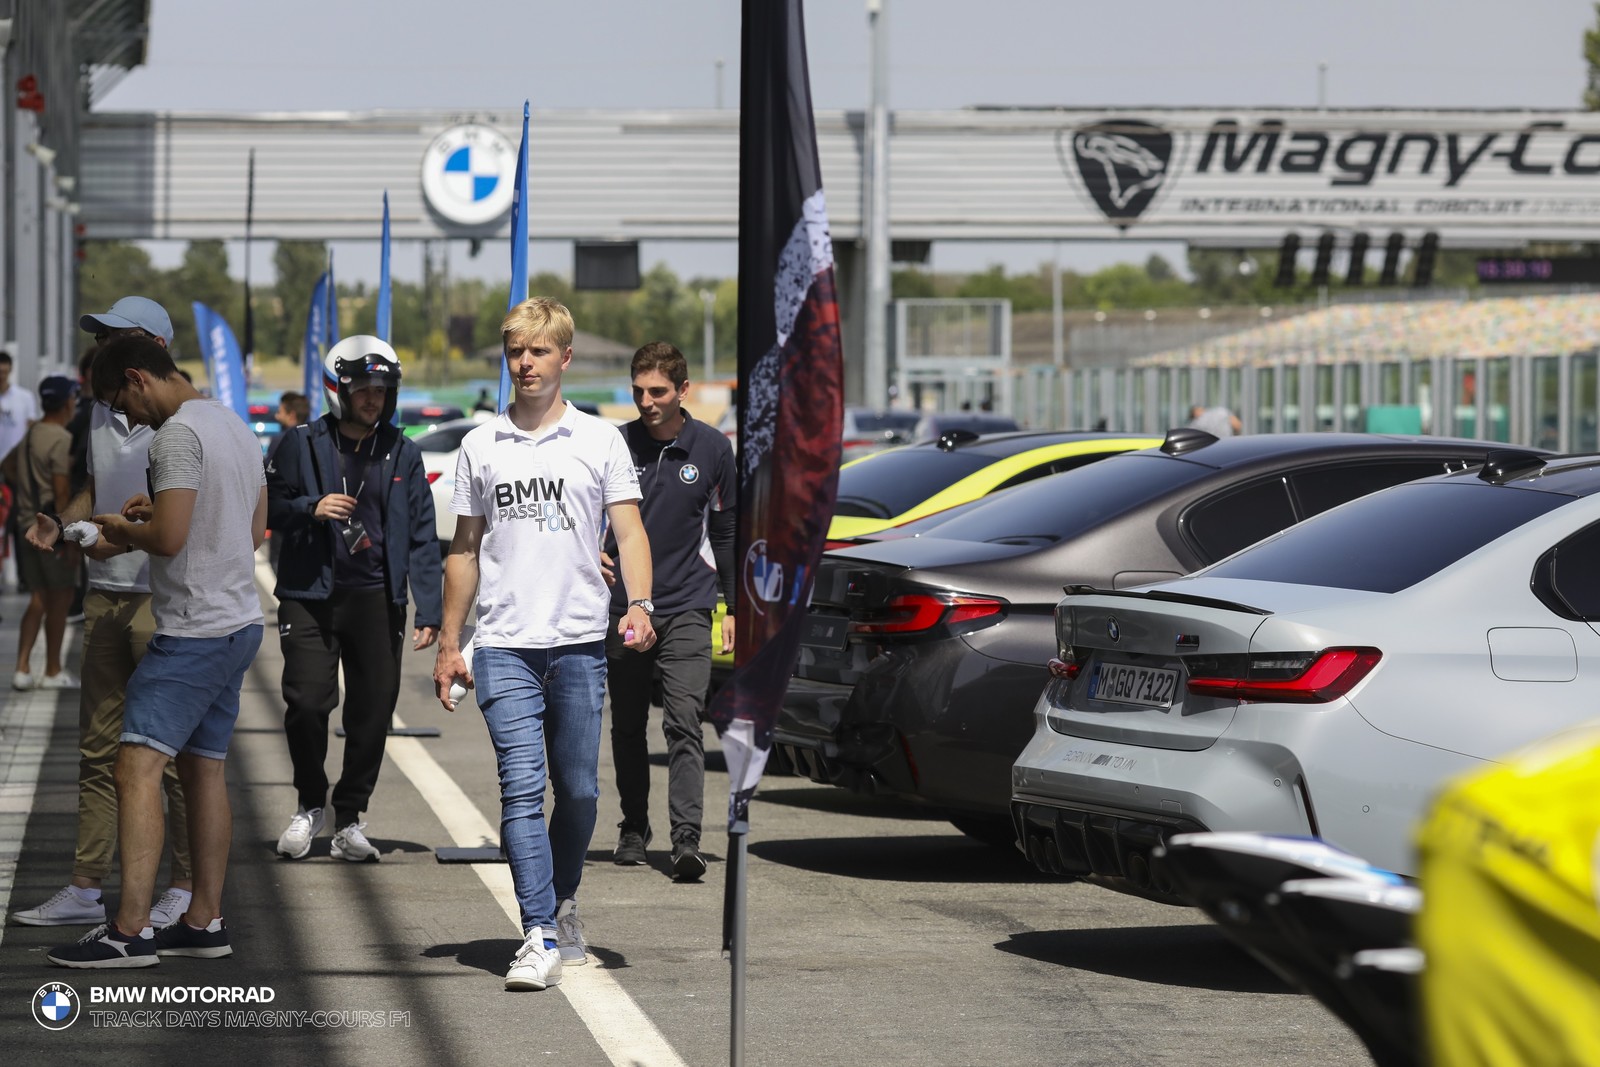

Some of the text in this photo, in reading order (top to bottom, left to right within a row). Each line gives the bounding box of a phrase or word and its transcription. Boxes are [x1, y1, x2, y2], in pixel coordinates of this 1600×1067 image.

[1181, 197, 1400, 214] INTERNATIONAL
[1416, 197, 1526, 214] CIRCUIT
[495, 477, 564, 508] BMW
[498, 502, 567, 523] PASSION
